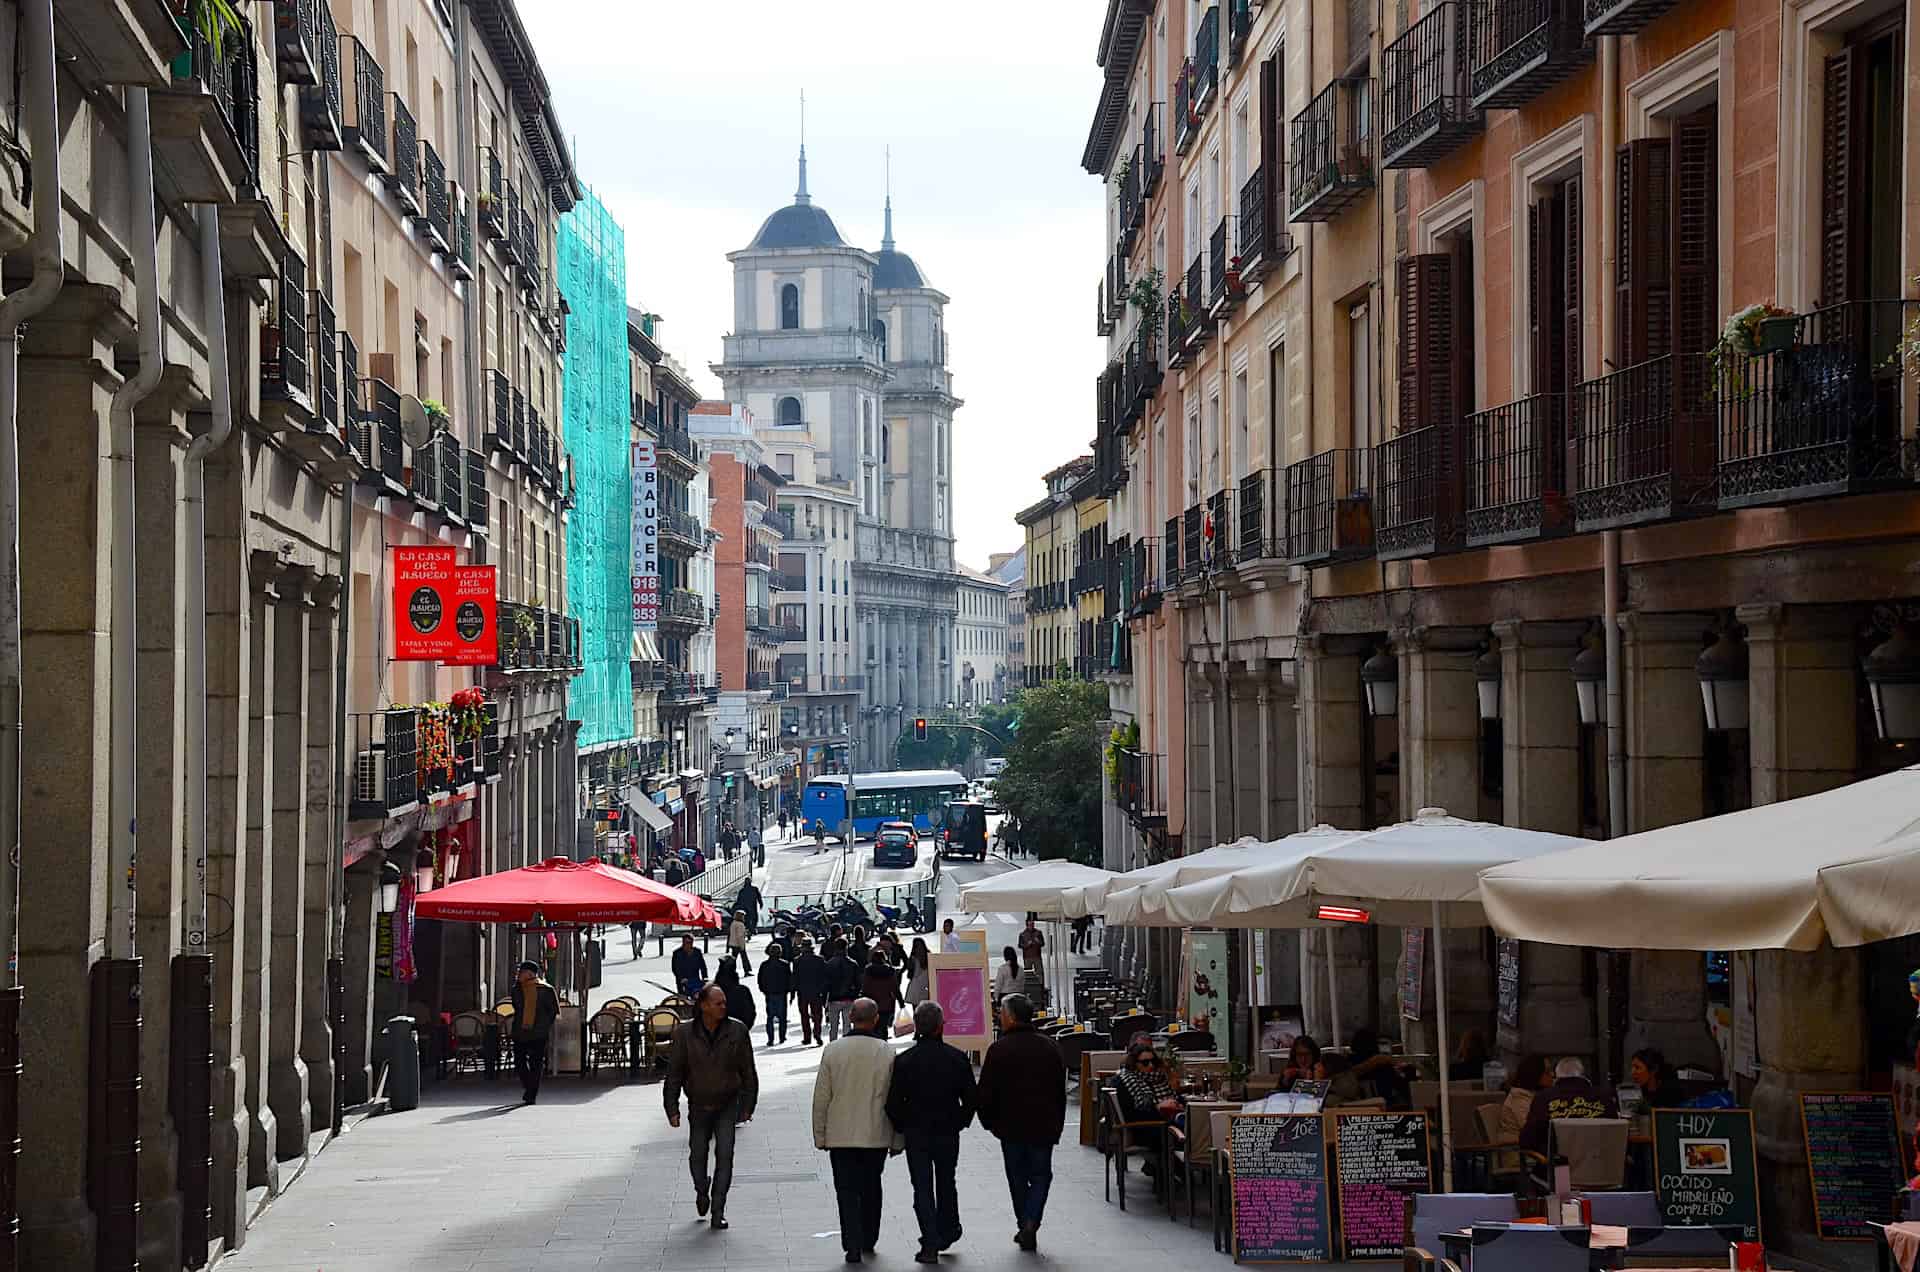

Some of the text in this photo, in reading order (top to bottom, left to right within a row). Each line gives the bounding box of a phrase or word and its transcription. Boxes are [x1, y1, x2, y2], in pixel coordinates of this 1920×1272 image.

[633, 471, 643, 573] ANDAMIOS
[644, 471, 656, 573] BAUGER
[400, 552, 451, 561] LA CASA
[413, 561, 437, 570] DEL
[400, 571, 448, 580] ABUELO
[463, 570, 491, 579] CASA
[460, 579, 480, 587] DEL
[632, 577, 657, 589] 918
[456, 587, 489, 595] BUELO
[632, 592, 657, 605] 093
[632, 607, 657, 620] 853
[1676, 1113, 1716, 1137] HOY
[1661, 1174, 1713, 1190] COCIDO
[1671, 1187, 1735, 1205] MADRILEÑO
[1666, 1203, 1724, 1217] COMPLETO
